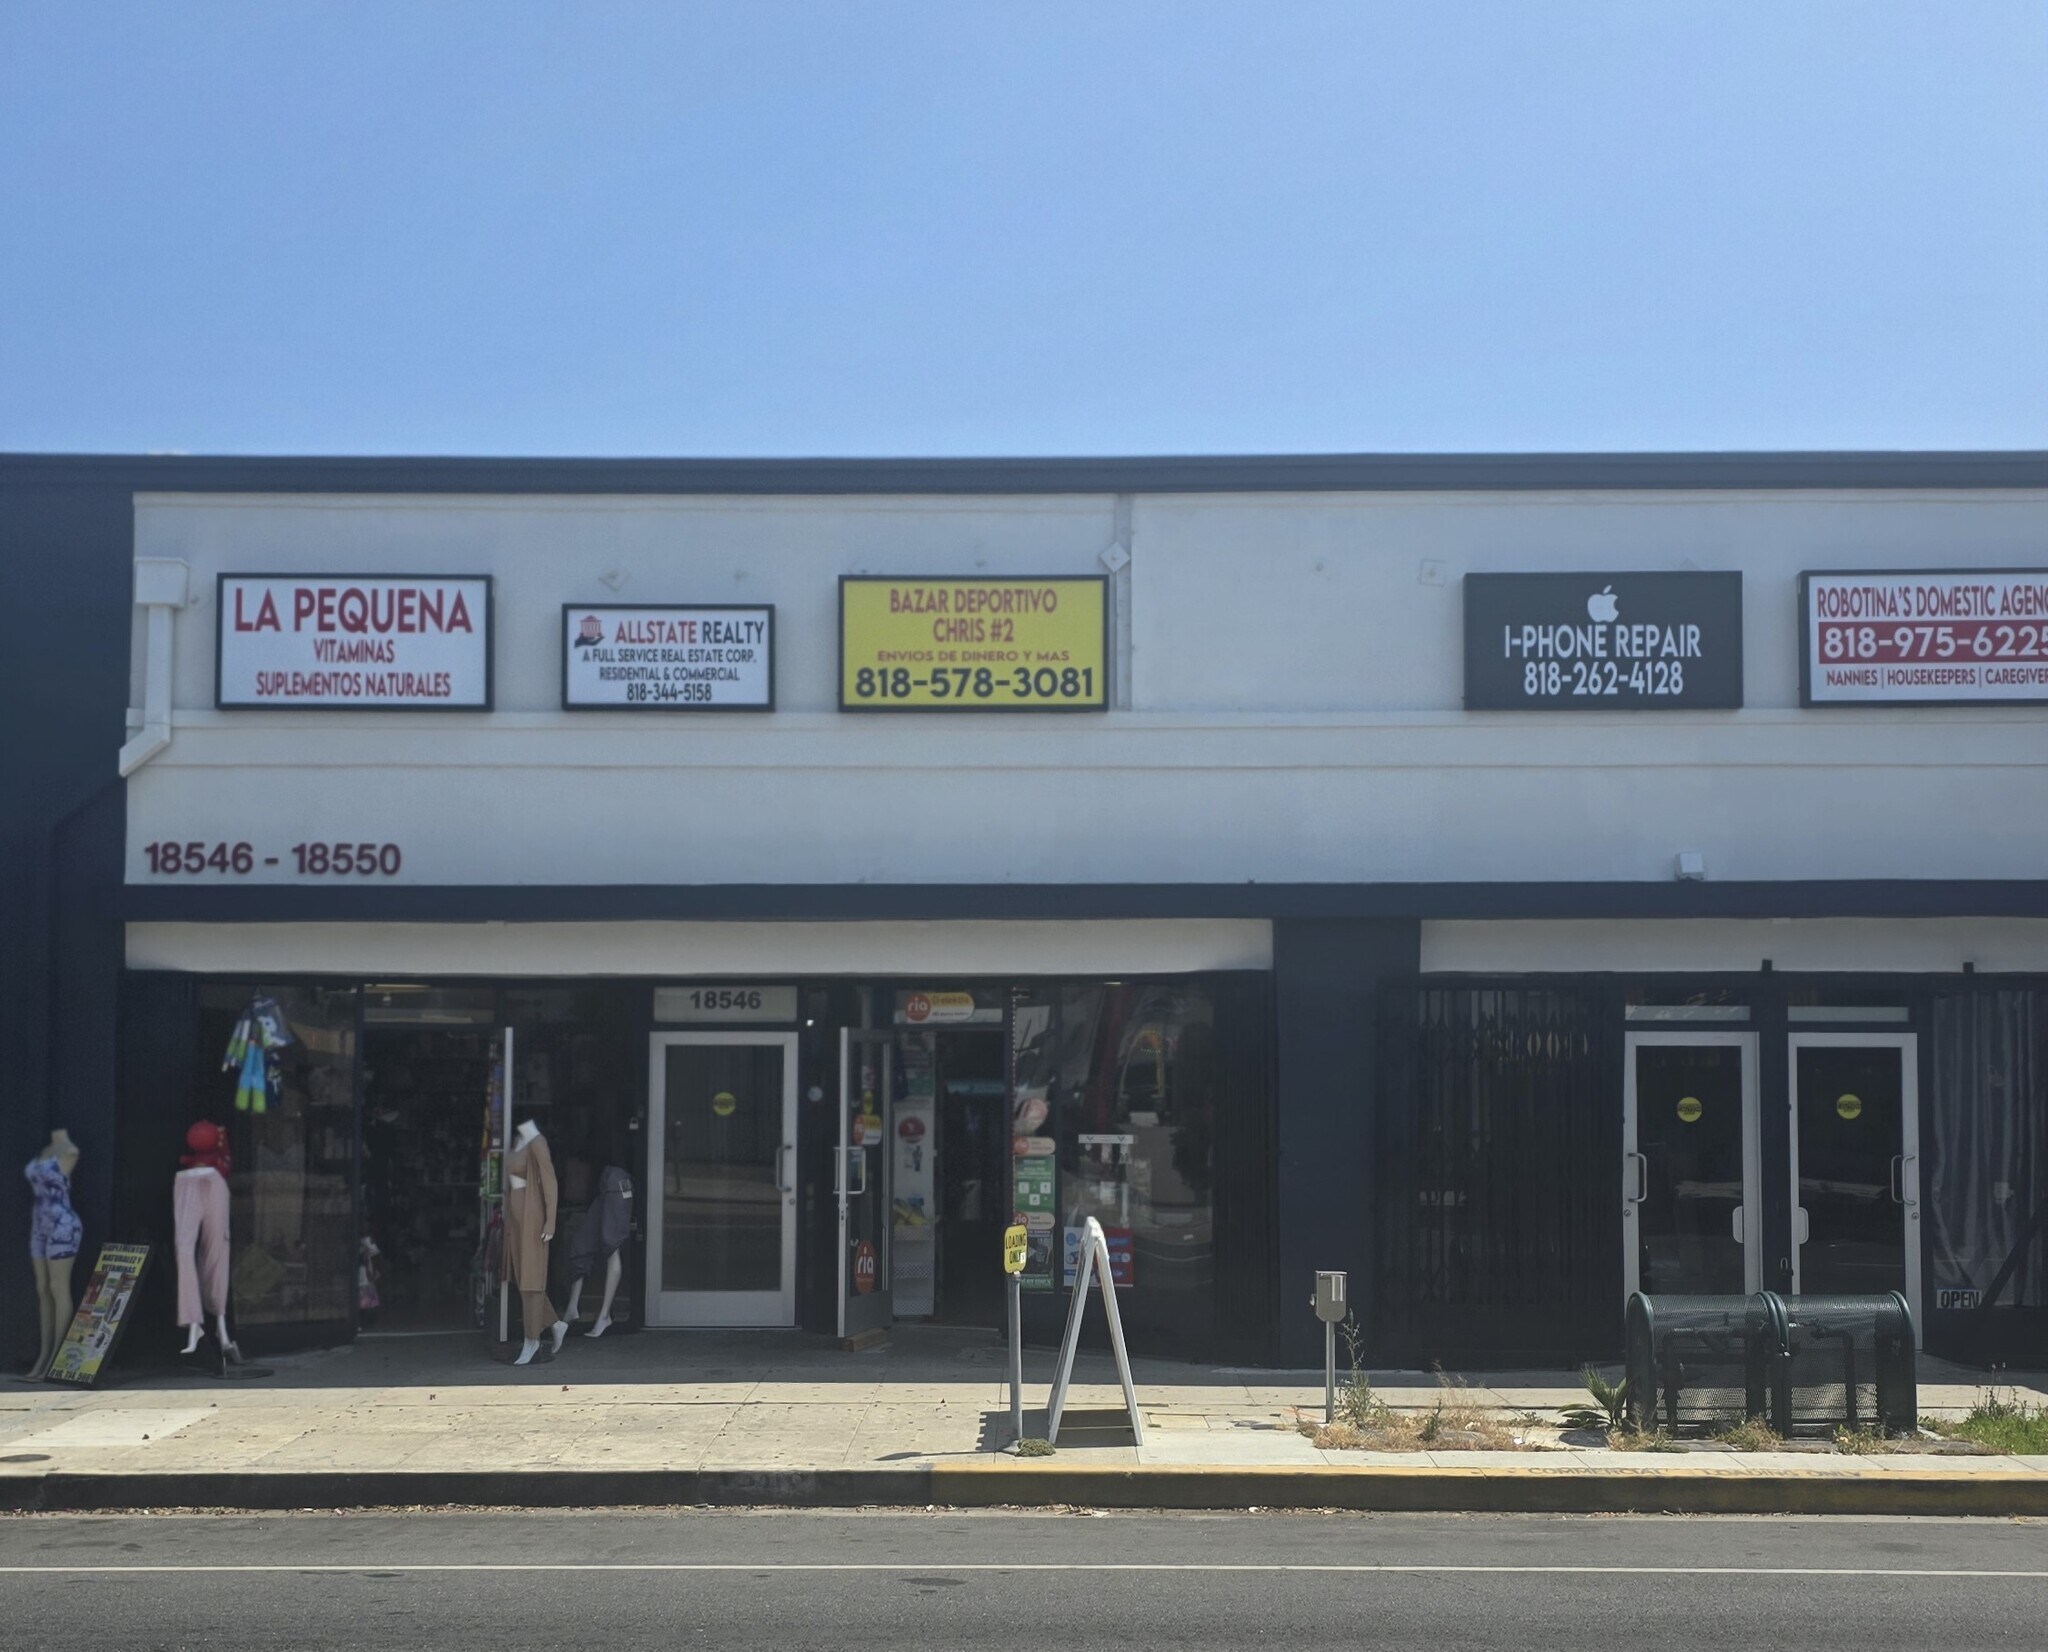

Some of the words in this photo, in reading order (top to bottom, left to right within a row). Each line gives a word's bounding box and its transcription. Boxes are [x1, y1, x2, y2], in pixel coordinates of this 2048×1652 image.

[234, 588, 281, 632] LA
[294, 588, 473, 634] PEQUENA
[890, 588, 949, 613] BAZAR
[955, 588, 1057, 613] DEPORTIVO
[1817, 586, 1912, 618] ROBOTINA'S
[1916, 585, 1996, 617] DOMESTIC
[615, 621, 697, 644] ALLSTATE
[702, 621, 765, 644] REALTY
[933, 618, 985, 642] CHRIS
[991, 618, 1014, 642] #2
[1504, 625, 1607, 658] I-PHONE
[1615, 625, 1702, 658] REPAIR
[314, 639, 394, 663] VITAMINAS
[582, 649, 591, 662] A
[593, 649, 615, 662] FULL
[618, 649, 658, 663] SERVICE
[661, 649, 685, 662] REAL
[688, 649, 723, 662] ESTATE
[726, 649, 757, 663] CORP.
[877, 650, 934, 662] ENVIOS
[938, 650, 957, 662] DE
[962, 650, 1018, 662] DINERO
[1022, 651, 1031, 661] Y
[1037, 651, 1070, 662] MAS
[256, 672, 361, 697] SUPLEMENTOS
[366, 672, 451, 697] NATURALES
[599, 667, 660, 681] RESIDENTIAL
[663, 667, 670, 680] &
[673, 667, 740, 681] COMMERCIAL
[855, 667, 1093, 698] 818-578-3081
[1524, 661, 1684, 695] 818-262-4128
[1827, 670, 1878, 686] NANNIES
[1887, 669, 1975, 686] HOUSEKEEPERS
[627, 683, 712, 701] 818-344-5158
[144, 842, 254, 874] 18546
[291, 843, 402, 875] 18550
[690, 991, 761, 1010] 18546
[908, 997, 928, 1011] ria
[1005, 1233, 1026, 1249] LOADING
[857, 1246, 874, 1274] ria
[1941, 1291, 1980, 1308] OPEN
[1528, 1467, 1667, 1475] COMMERCIAL
[1700, 1468, 1800, 1476] LOADING
